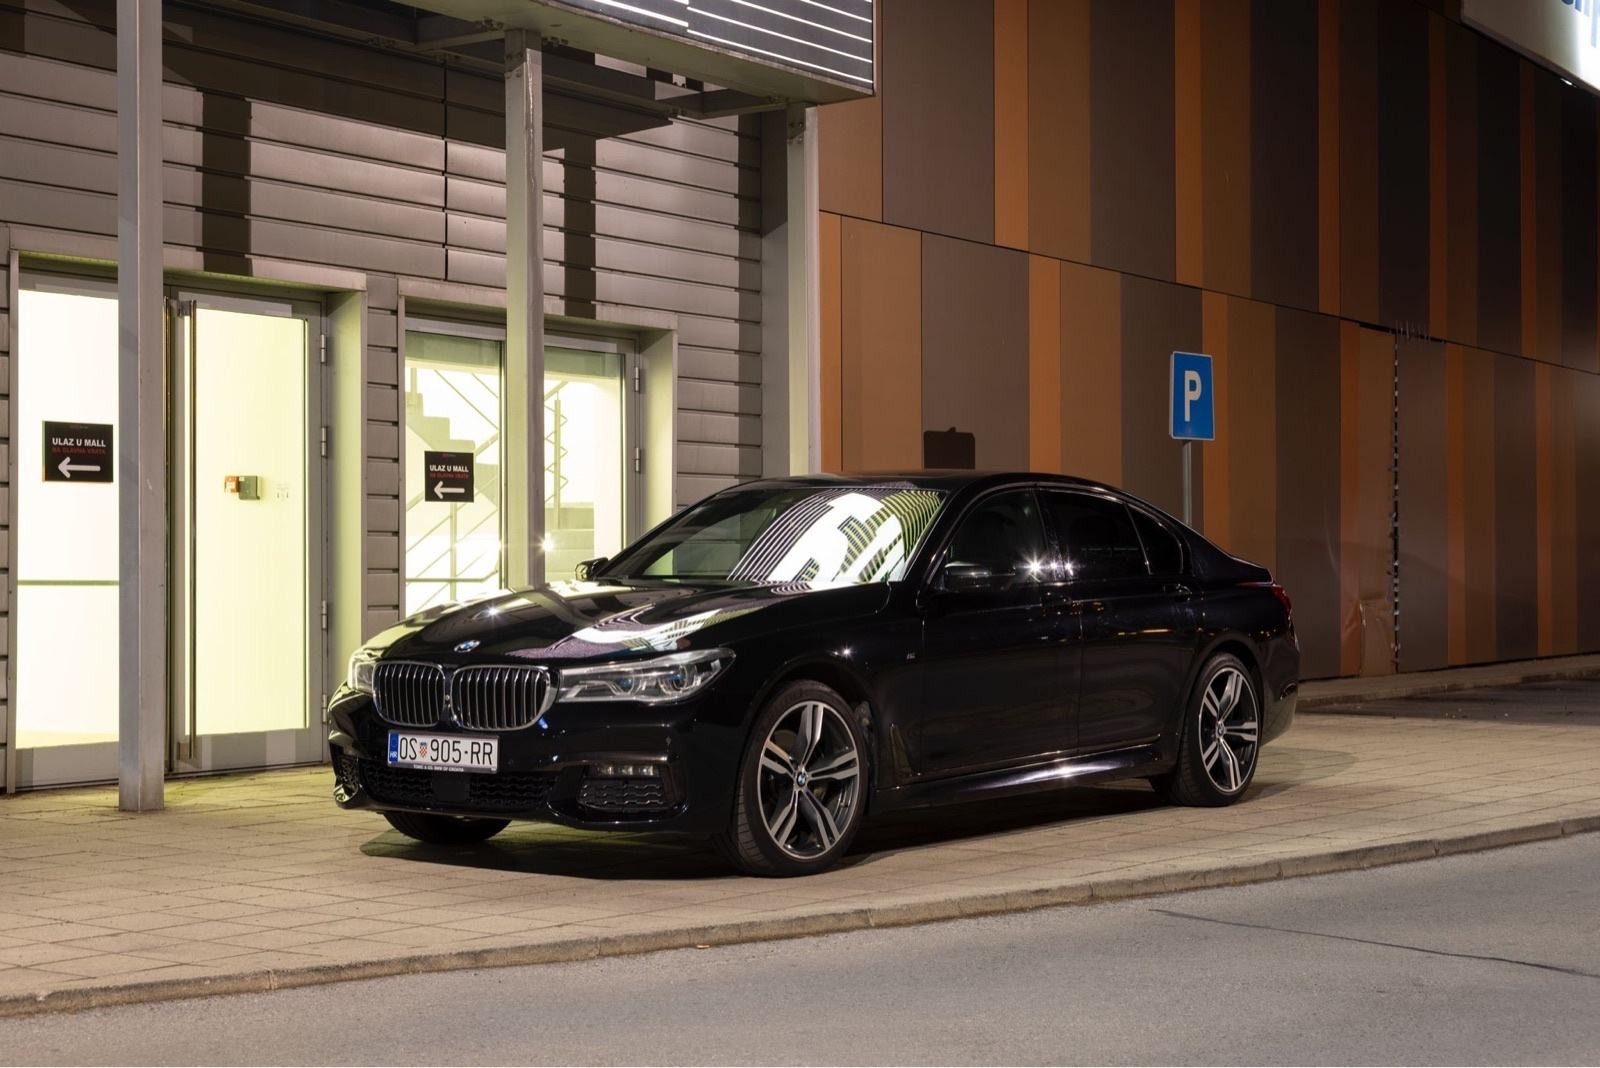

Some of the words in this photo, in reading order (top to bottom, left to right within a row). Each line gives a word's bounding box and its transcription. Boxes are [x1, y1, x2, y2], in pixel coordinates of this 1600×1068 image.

[1184, 370, 1202, 422] P
[52, 437, 74, 446] ULAZ
[76, 438, 82, 446] U
[84, 439, 106, 447] MALL
[429, 464, 446, 472] ULAZ
[452, 465, 469, 473] MALL
[399, 737, 418, 760] OS
